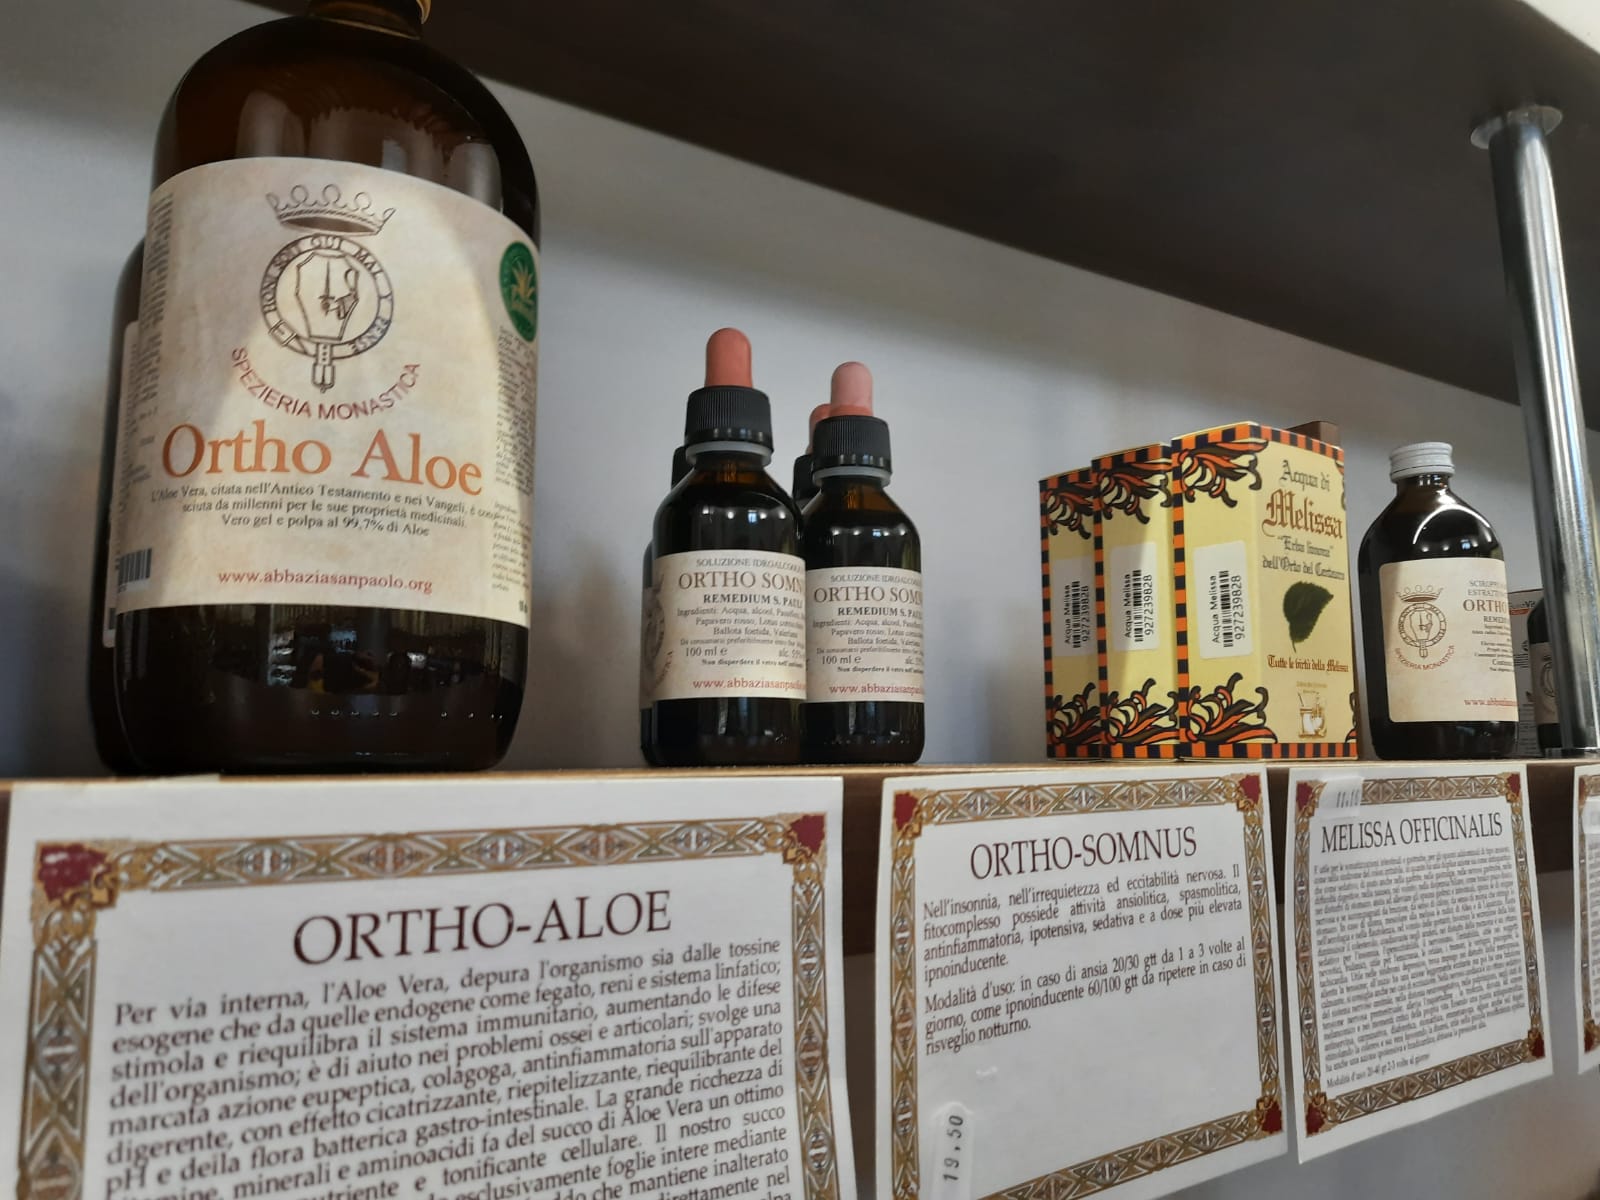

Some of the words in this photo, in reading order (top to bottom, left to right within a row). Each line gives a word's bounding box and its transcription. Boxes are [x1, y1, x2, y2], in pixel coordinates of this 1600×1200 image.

[231, 347, 312, 418] SPEZIERIA
[317, 362, 421, 420] MONASTICA
[162, 419, 332, 478] Ortho
[351, 427, 483, 496] Aloe
[1280, 459, 1318, 492] Acqua
[1320, 472, 1330, 492] di
[182, 500, 212, 513] sciuta
[215, 499, 230, 511] da
[231, 498, 283, 511] millenni
[286, 501, 307, 514] per
[311, 500, 323, 511] le
[326, 502, 348, 513] sue
[352, 504, 407, 519] proprietà
[410, 510, 466, 528] medicinali.
[211, 483, 242, 495] citata
[245, 482, 314, 496] nell'Antico
[319, 484, 391, 502] Testamento
[393, 493, 402, 502] e
[222, 513, 250, 526] Vero
[253, 513, 273, 528] gel
[276, 516, 284, 526] e
[287, 515, 324, 528] polpa
[327, 516, 339, 528] al
[386, 520, 399, 533] di
[401, 522, 430, 537] Aloe
[1262, 488, 1343, 539] Melissa
[218, 569, 433, 595] www.abbaziasanpaolo.org
[678, 570, 756, 590] ORTHO
[703, 593, 771, 605] REMEDIUM
[814, 586, 885, 604] ORTHO
[1063, 585, 1071, 616] Melissa
[1123, 574, 1131, 607] Melissa
[1210, 575, 1218, 610] Melissa
[837, 607, 898, 617] REMEDIUM
[1124, 610, 1132, 638] Acqua
[1142, 574, 1154, 636] 927239828
[1231, 574, 1246, 640] 927239828
[1212, 614, 1222, 643] Acqua
[685, 647, 702, 657] 100
[704, 646, 717, 657] ml
[821, 655, 837, 665] 100
[839, 655, 851, 664] ml
[970, 826, 1198, 880] ORTHO-SOMNUS
[1321, 816, 1397, 853] MELISSA
[1399, 811, 1503, 845] OFFICINALIS
[923, 892, 1001, 920] Nell'insonnia,
[1008, 881, 1100, 906] nell'irrequietezza
[1106, 877, 1120, 893] ed
[1127, 869, 1180, 891] eccitabilità
[1186, 868, 1226, 884] nervosa.
[1232, 863, 1240, 878] Il
[923, 914, 1001, 940] fitocomplesso
[1012, 902, 1059, 931] possiede
[1070, 896, 1106, 916] attività
[1116, 889, 1169, 910] ansiolitica,
[1179, 881, 1241, 904] spasmolitica,
[293, 890, 673, 965] ORTHO-ALOE
[1030, 921, 1088, 946] ipotensiva,
[1092, 914, 1135, 932] sedativa
[1138, 913, 1145, 924] e
[1149, 911, 1156, 922] a
[1160, 905, 1183, 921] dose
[1188, 902, 1205, 921] più
[1209, 898, 1243, 915] elevata
[115, 1003, 157, 1026] Per
[169, 997, 208, 1020] via
[220, 990, 309, 1015] interna,
[323, 979, 387, 1004] l'Aloe
[398, 974, 449, 995] Vera,
[460, 967, 530, 992] depura
[539, 954, 643, 981] l'organismo
[652, 948, 674, 967] sia
[682, 942, 721, 963] dalle
[729, 938, 781, 957] tossine
[924, 951, 1009, 987] ipnoinducente.
[925, 985, 977, 1013] Modalità
[981, 981, 1016, 1000] d'uso:
[1020, 975, 1032, 991] in
[1036, 972, 1061, 987] caso
[1065, 965, 1076, 982] di
[1080, 960, 1108, 979] ansia
[1112, 953, 1140, 973] 20/30
[1161, 948, 1174, 964] da
[1178, 946, 1184, 961] 1
[1188, 948, 1194, 959] a
[1198, 943, 1205, 958] 3
[1208, 939, 1233, 955] volte
[1236, 936, 1246, 951] al
[112, 1027, 214, 1056] esogene
[220, 1017, 261, 1042] che
[267, 1013, 296, 1036] da
[301, 1005, 370, 1033] quelle
[374, 997, 475, 1022] endogene
[480, 990, 531, 1011] come
[535, 980, 595, 1007] fegato,
[600, 974, 633, 995] reni
[637, 976, 647, 990] e
[651, 966, 711, 988] sistema
[715, 959, 781, 980] linfatico;
[925, 1014, 967, 1040] giorno,
[970, 1004, 1001, 1023] come
[1005, 984, 1084, 1019] ipnoinducente
[1087, 975, 1122, 997] 60/100
[1141, 970, 1155, 986] da
[1158, 963, 1197, 986] ripetere
[1199, 960, 1209, 975] in
[1212, 958, 1234, 973] caso
[1236, 953, 1247, 967] di
[111, 1050, 205, 1081] stimola
[214, 1051, 228, 1069] e
[238, 1033, 358, 1068] riequilibra
[368, 1026, 382, 1048] il
[391, 1020, 468, 1046] sistema
[476, 1002, 598, 1035] immunitario,
[605, 985, 712, 1017] aumentando
[717, 983, 731, 1002] le
[736, 979, 781, 999] difese
[978, 1017, 1032, 1041] notturno.
[109, 1069, 301, 1109] dell'organismo;
[308, 1058, 321, 1081] è
[328, 1056, 349, 1079] di
[356, 1052, 412, 1075] aiuto
[418, 1043, 450, 1066] nei
[456, 1030, 543, 1066] problemi
[549, 1025, 593, 1047] ossei
[598, 1025, 609, 1040] e
[613, 1014, 694, 1038] articolari;
[698, 1005, 749, 1026] svolge
[753, 1000, 781, 1017] una
[108, 1104, 210, 1136] marcata
[217, 1094, 297, 1121] azione
[302, 1076, 415, 1108] eupeptica,
[422, 1060, 516, 1089] colagoga,
[680, 1020, 783, 1049] sull'apparato
[943, 1115, 965, 1182] 19,50
